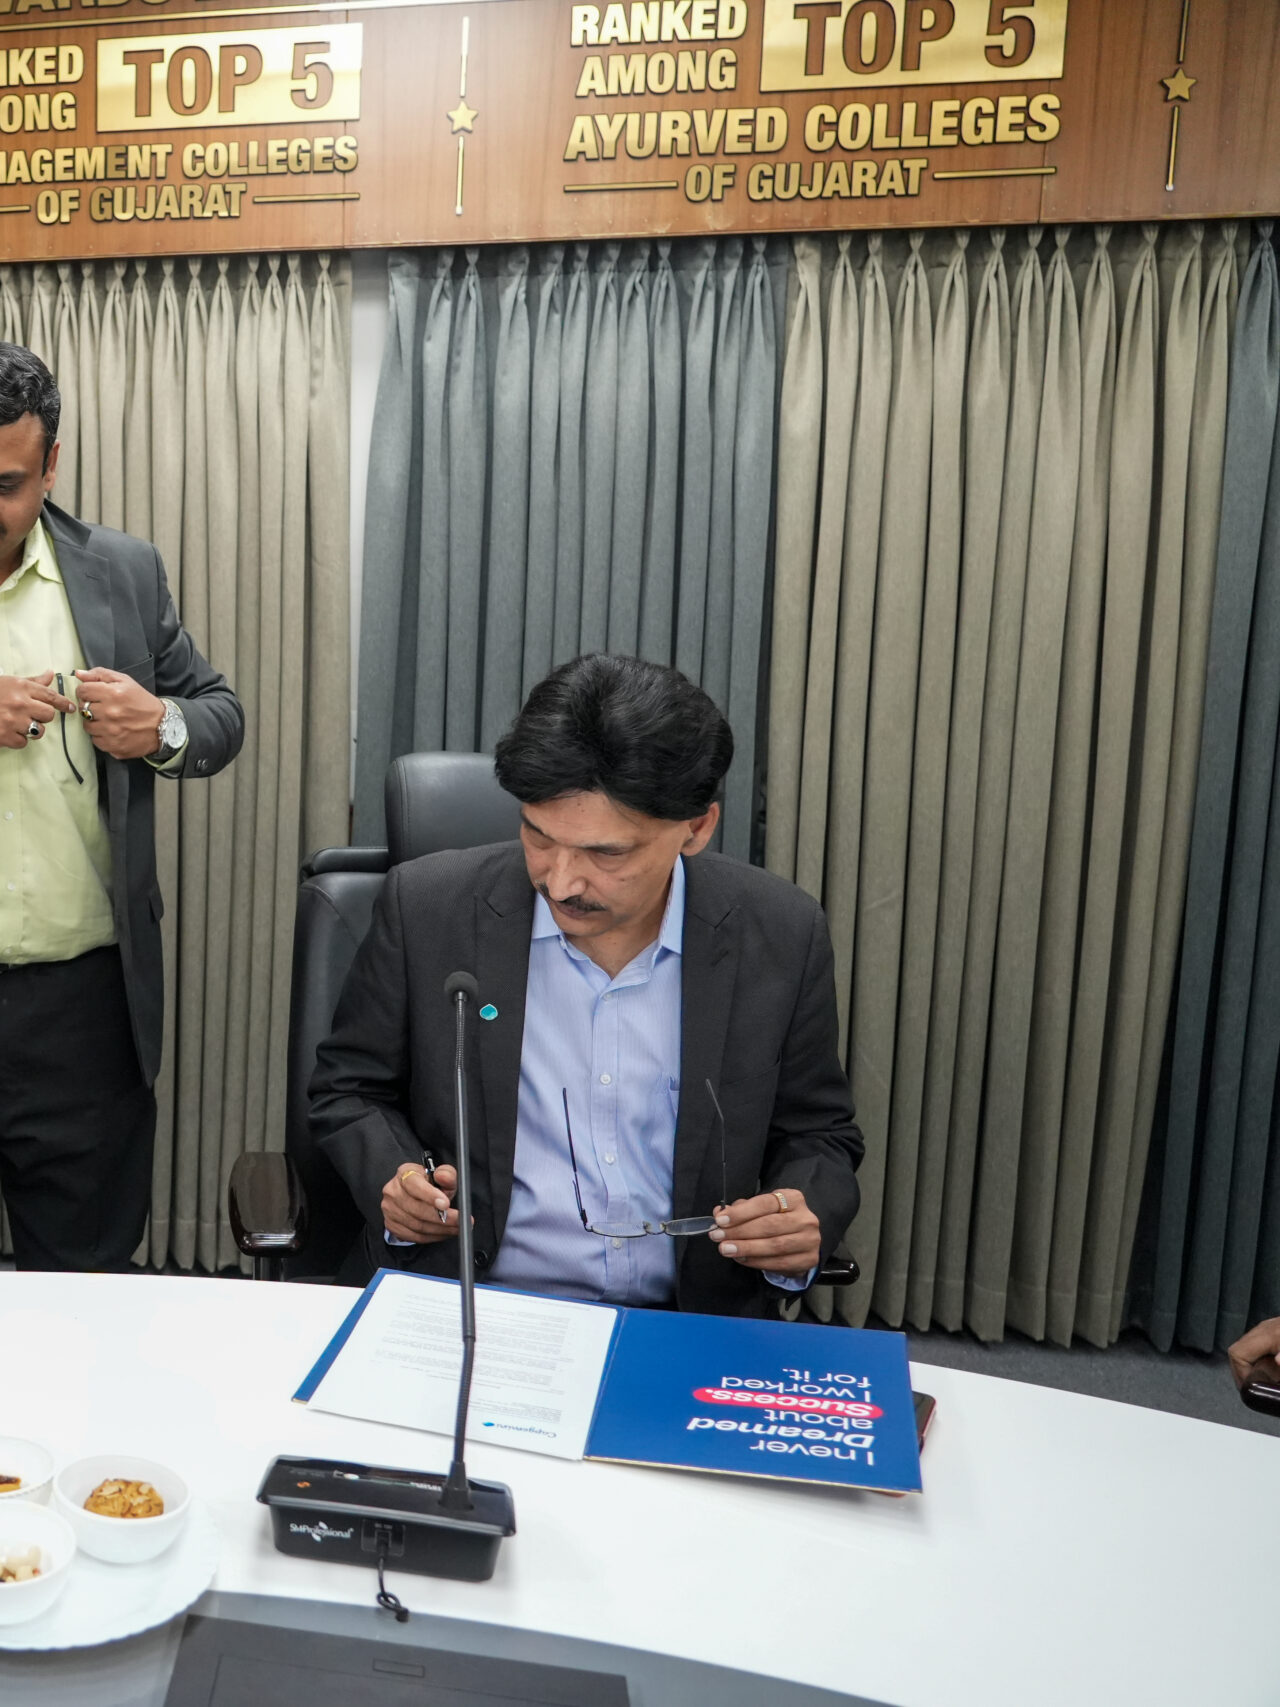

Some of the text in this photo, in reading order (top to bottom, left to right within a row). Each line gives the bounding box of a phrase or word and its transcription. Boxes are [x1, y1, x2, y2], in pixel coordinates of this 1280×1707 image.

[571, 0, 748, 47] RANKED
[794, 0, 1035, 76] TOP 5
[122, 42, 334, 118] TOP 5
[575, 48, 737, 97] AMONG
[562, 93, 1061, 161] AYURVED COLLEGES
[182, 135, 359, 179] COLLEGES
[685, 158, 928, 202] OF GUJARAT
[37, 183, 247, 224] OF GUJARAT
[721, 1376, 871, 1402] I worked
[782, 1368, 871, 1388] for it.
[705, 1388, 873, 1417] Success.
[765, 1409, 874, 1430] about
[686, 1417, 875, 1449] Dreamed
[749, 1439, 874, 1465] I never
